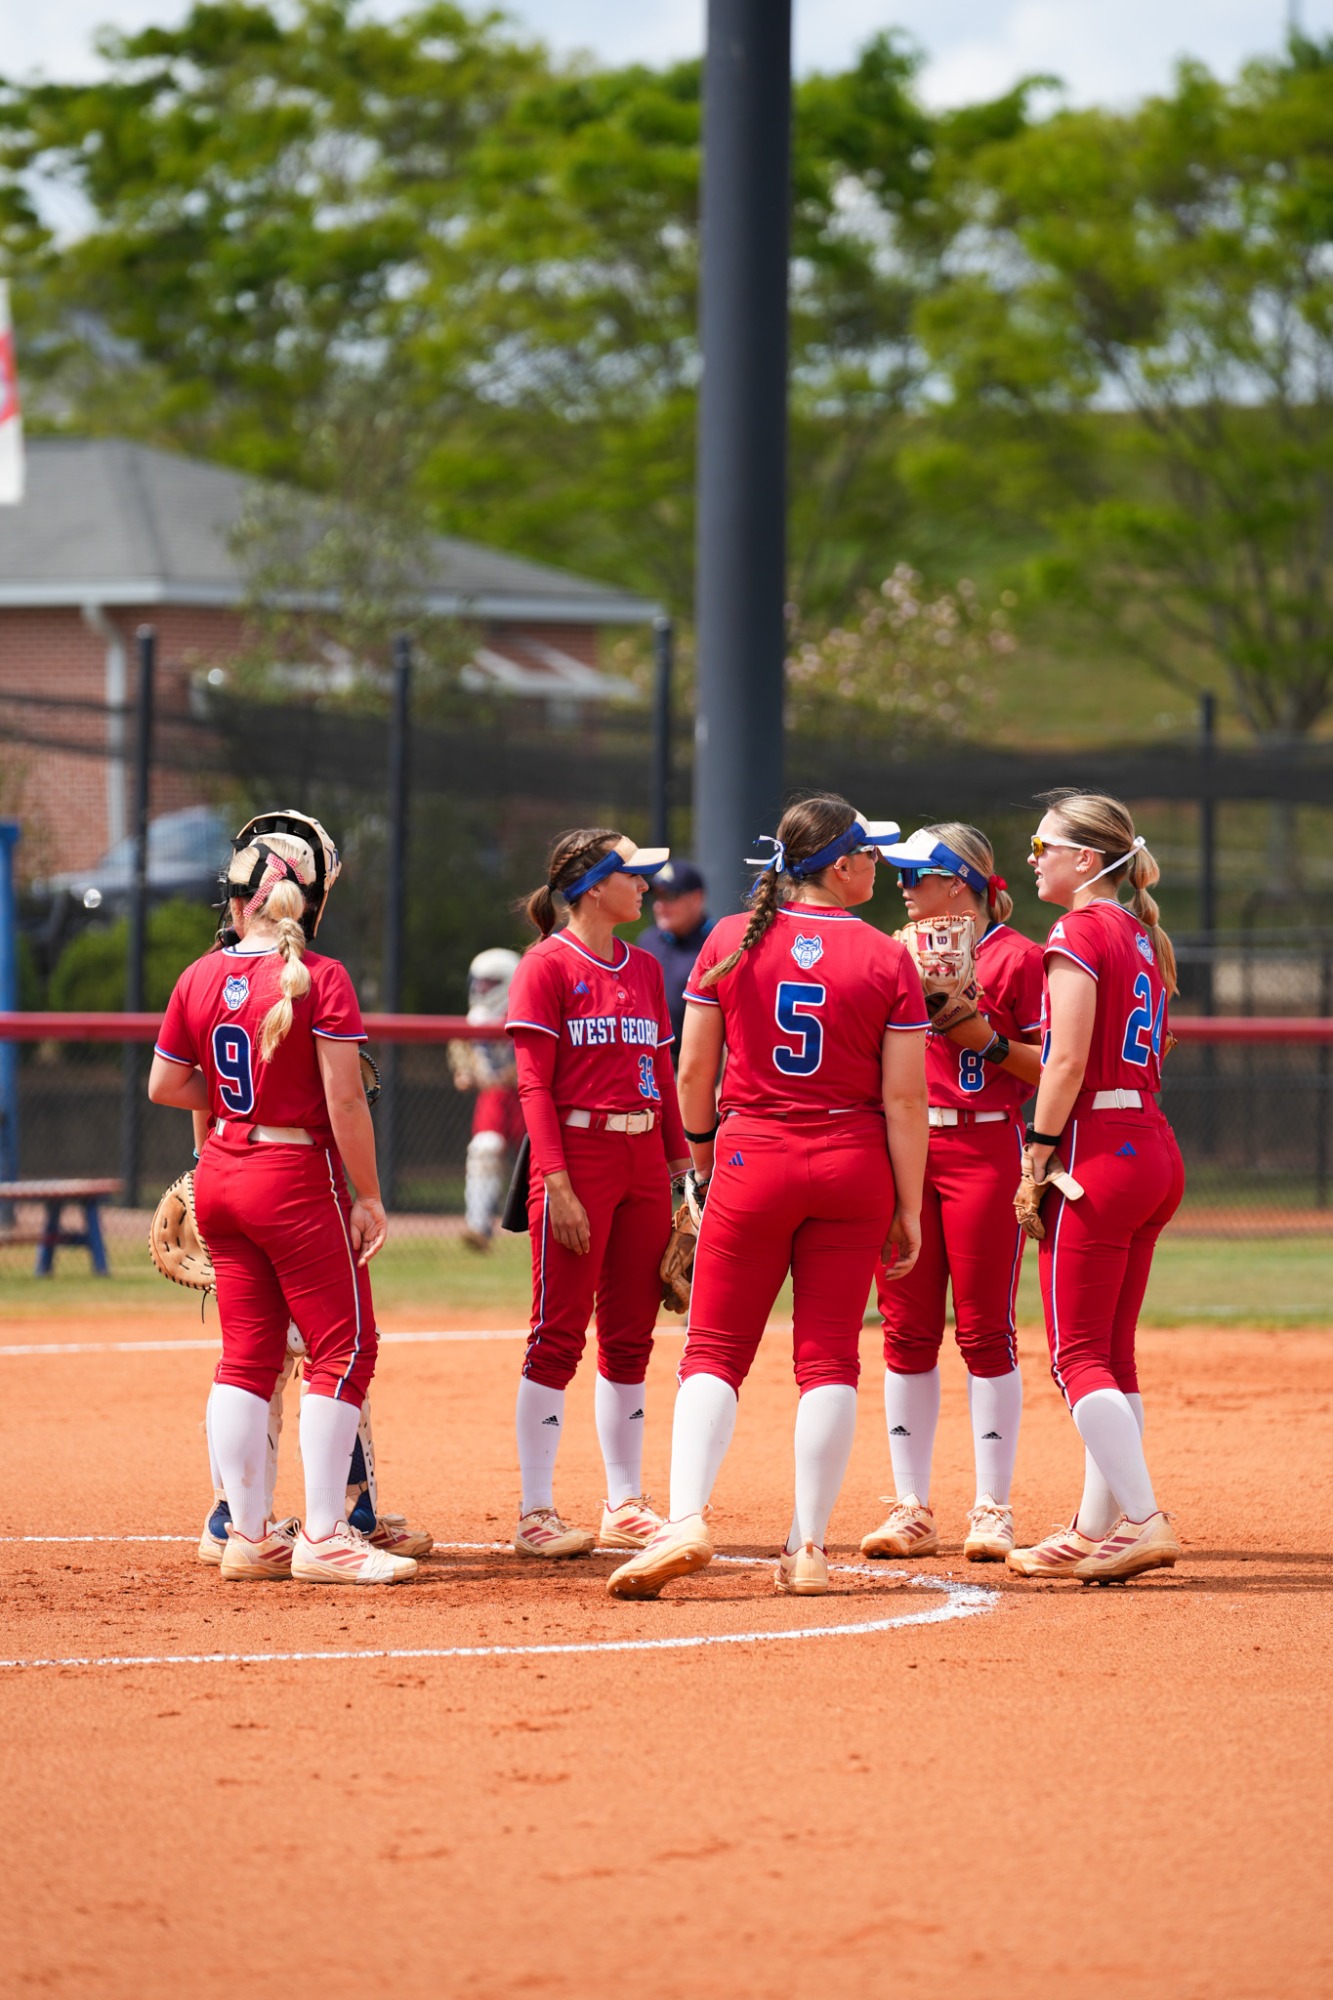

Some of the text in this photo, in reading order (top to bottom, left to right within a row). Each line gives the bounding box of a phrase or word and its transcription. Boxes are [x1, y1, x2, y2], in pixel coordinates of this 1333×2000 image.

[566, 1016, 617, 1047] WEST
[773, 980, 826, 1077] 5
[1121, 971, 1167, 1079] 24
[212, 1023, 254, 1115] 9
[638, 1053, 662, 1101] 32
[958, 1047, 986, 1093] 8
